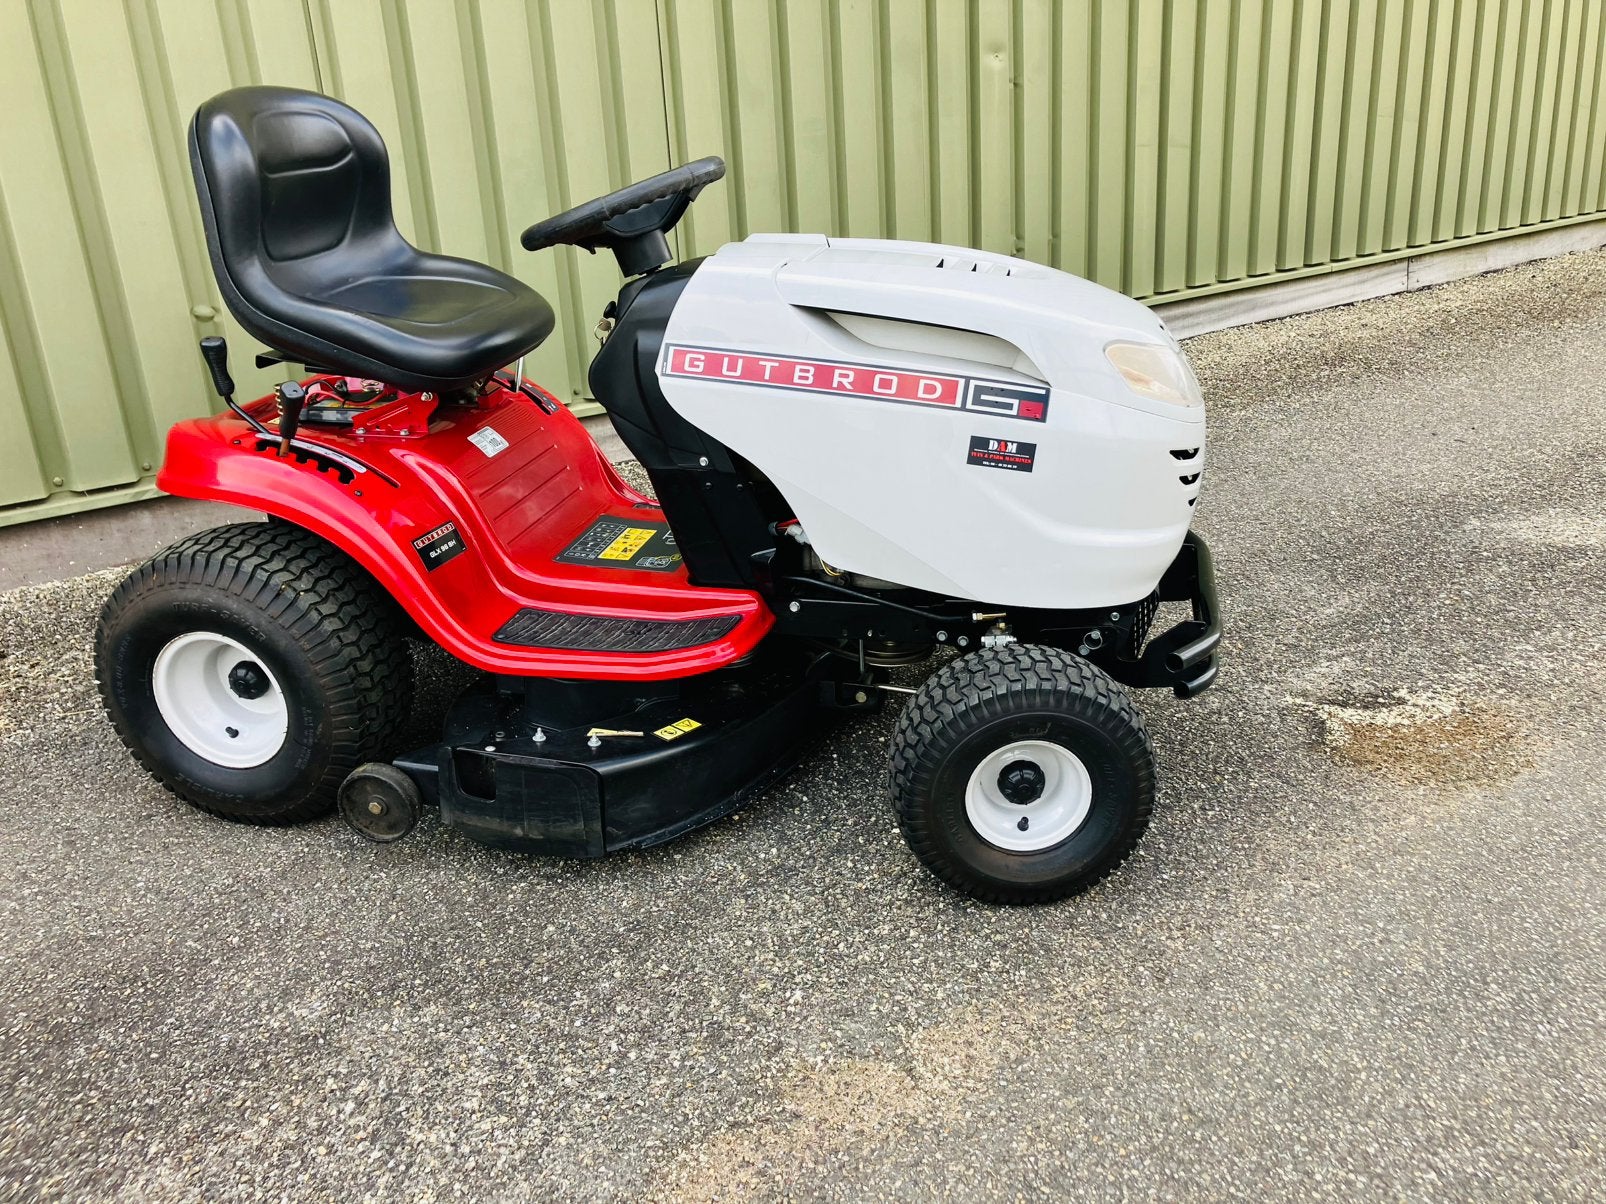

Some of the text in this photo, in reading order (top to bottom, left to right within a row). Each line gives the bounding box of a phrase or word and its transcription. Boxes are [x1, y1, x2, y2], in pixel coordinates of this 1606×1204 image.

[683, 353, 943, 400] GUTBROD
[988, 439, 1018, 453] DAM
[415, 523, 454, 548] GUTBROD
[429, 547, 442, 558] GLX
